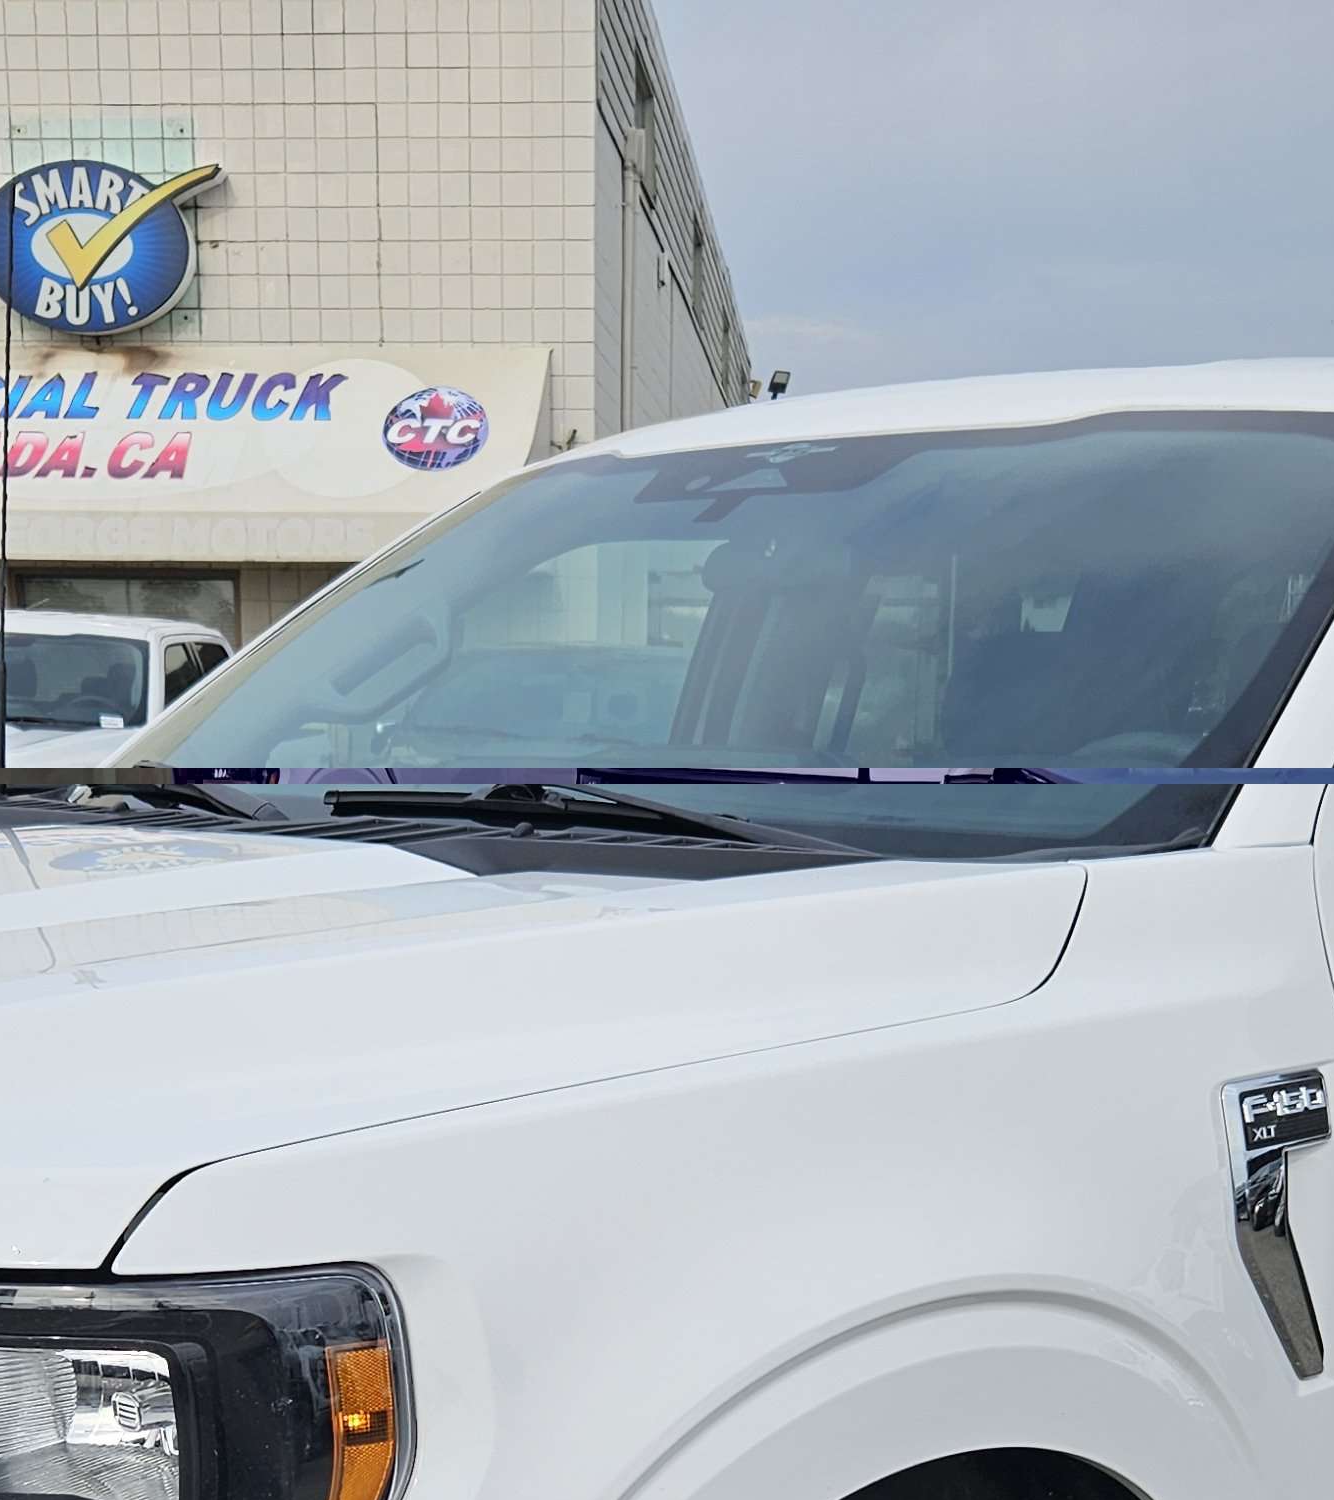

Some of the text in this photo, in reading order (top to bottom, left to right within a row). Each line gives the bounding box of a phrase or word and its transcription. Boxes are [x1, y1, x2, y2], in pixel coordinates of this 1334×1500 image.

[14, 166, 150, 227] SMART
[34, 276, 139, 326] BUY!
[126, 372, 349, 421] TRUCK
[387, 419, 481, 445] CTC
[1242, 1086, 1327, 1124] F-150
[1253, 1124, 1278, 1142] XLT
